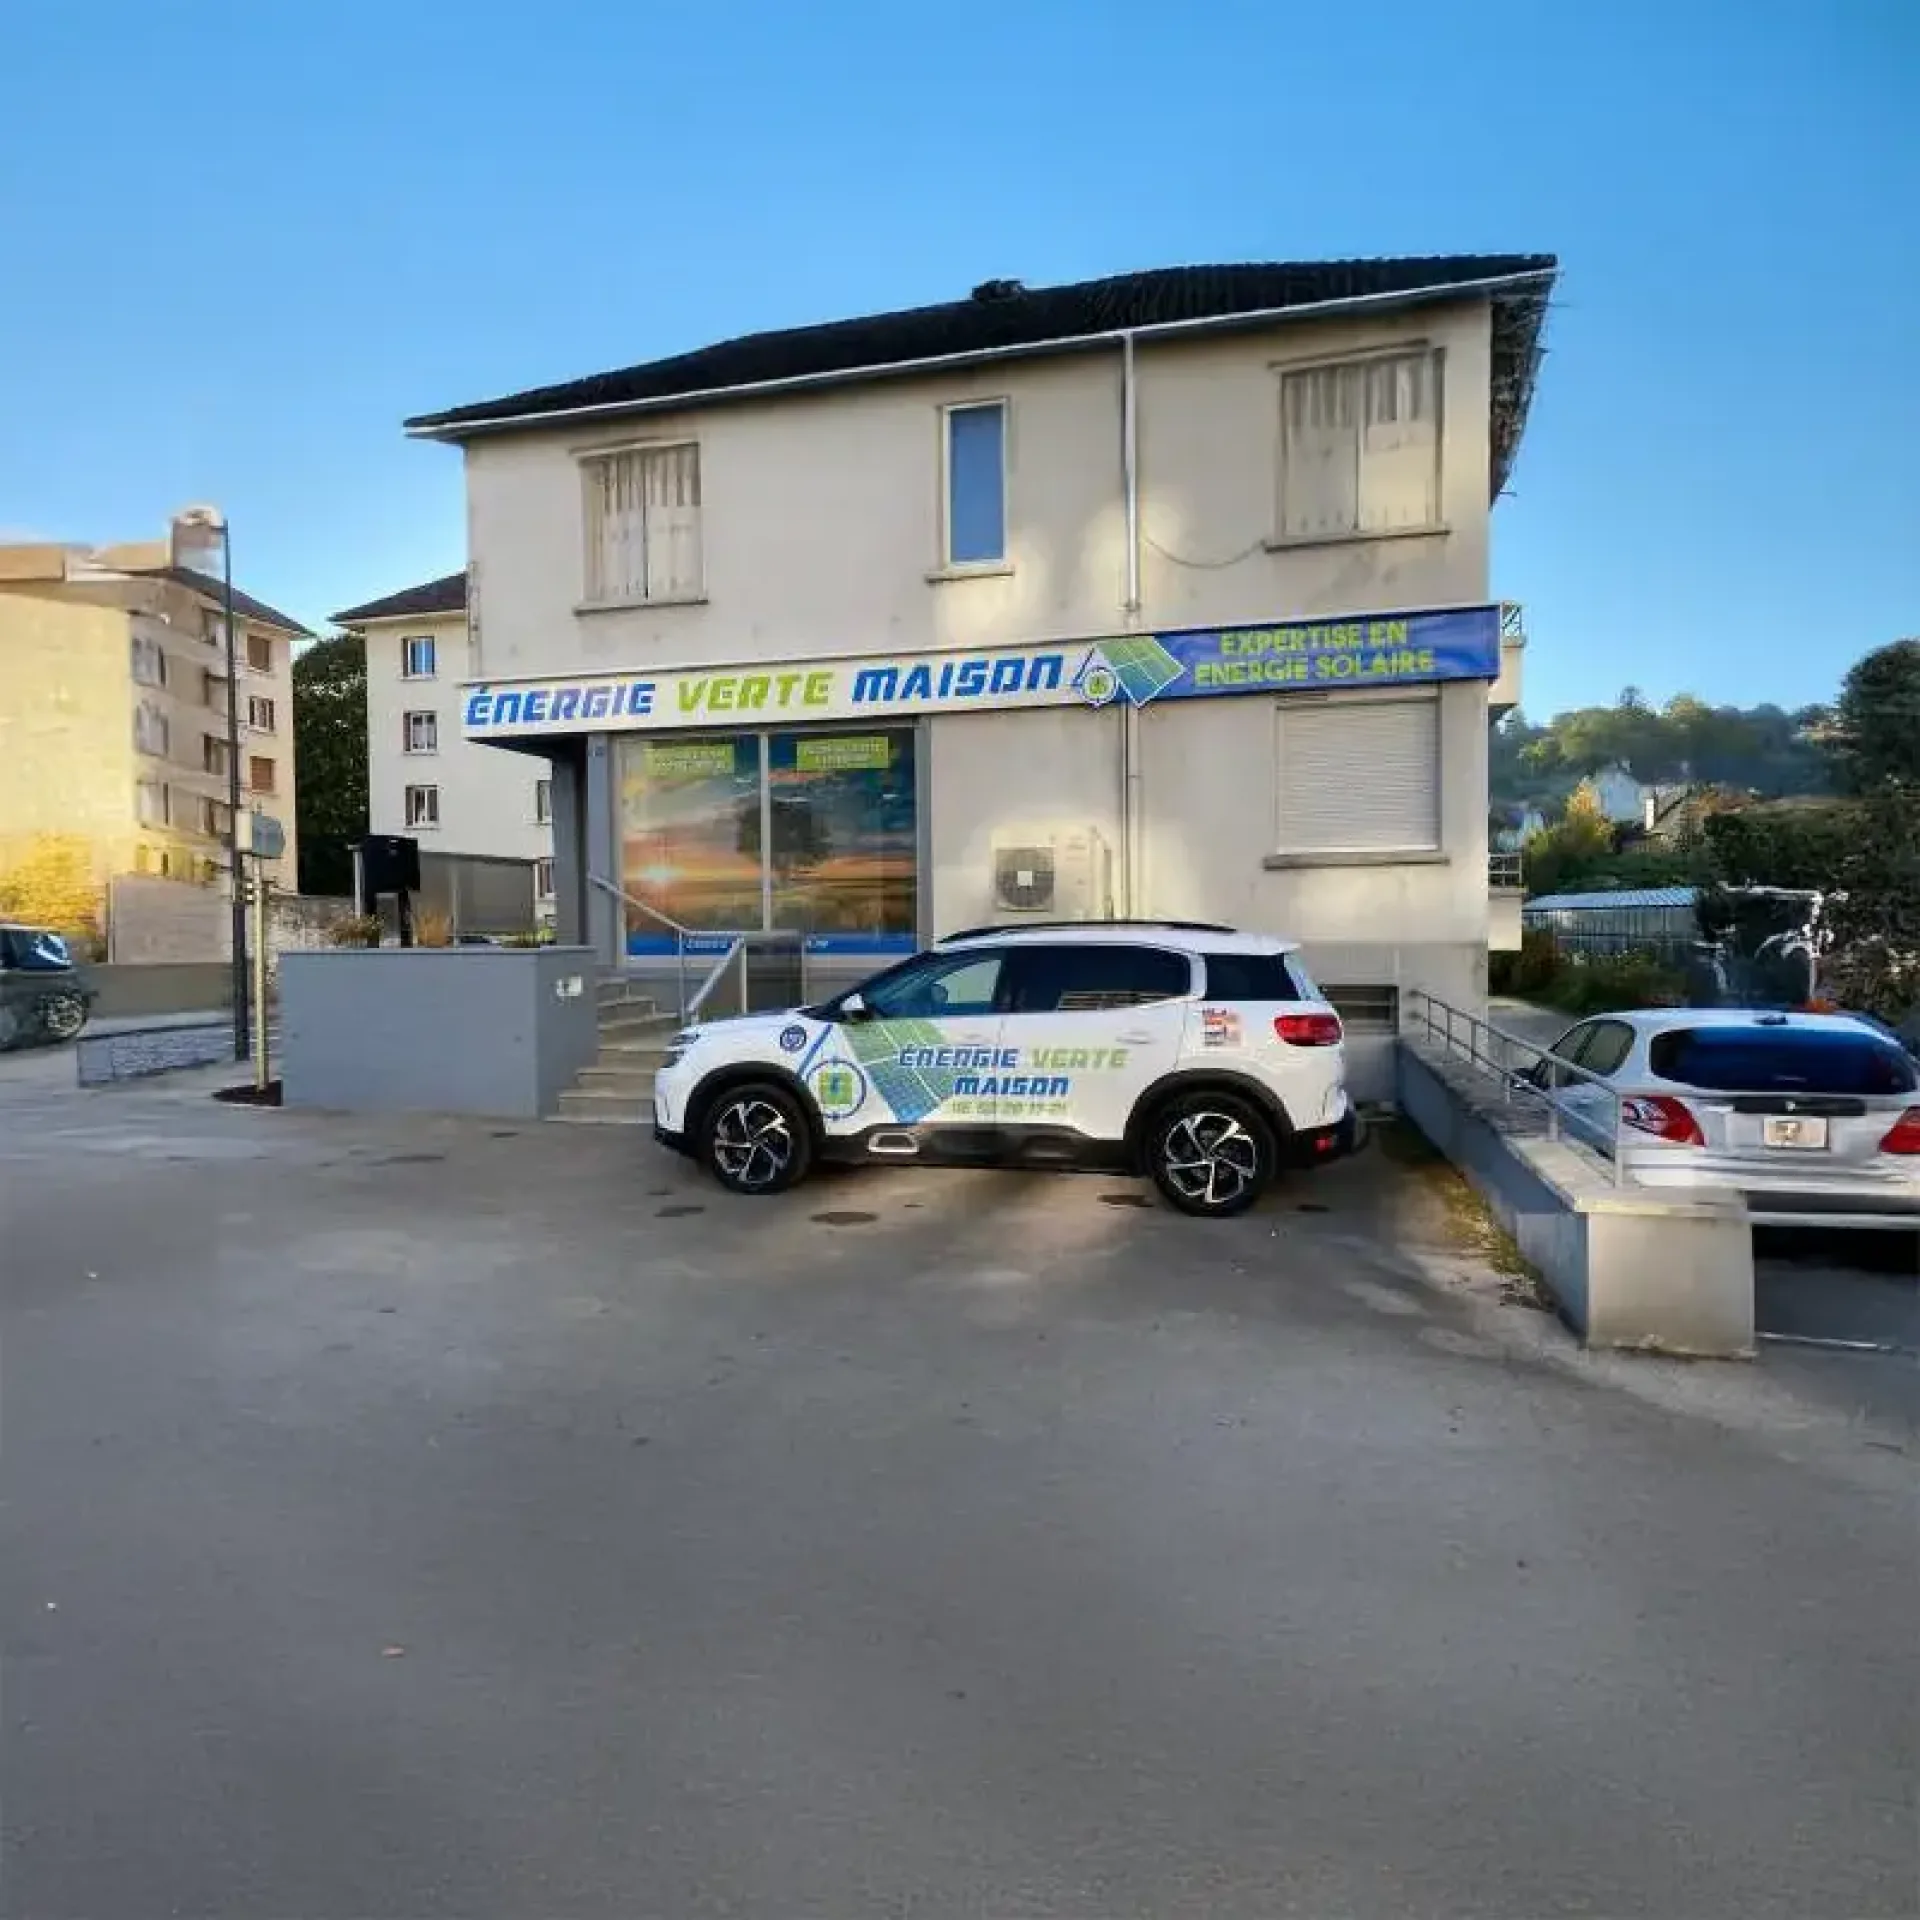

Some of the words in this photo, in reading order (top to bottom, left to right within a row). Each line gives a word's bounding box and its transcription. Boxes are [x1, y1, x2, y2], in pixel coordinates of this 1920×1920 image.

[1220, 623, 1363, 654] EXPERTISE
[1369, 620, 1407, 646] EN
[1316, 650, 1434, 678] SOLAIRE
[679, 671, 833, 711] VERTE
[852, 655, 1063, 703] MAISON
[1032, 1048, 1129, 1068] VERTE
[954, 1077, 1069, 1095] MAISON
